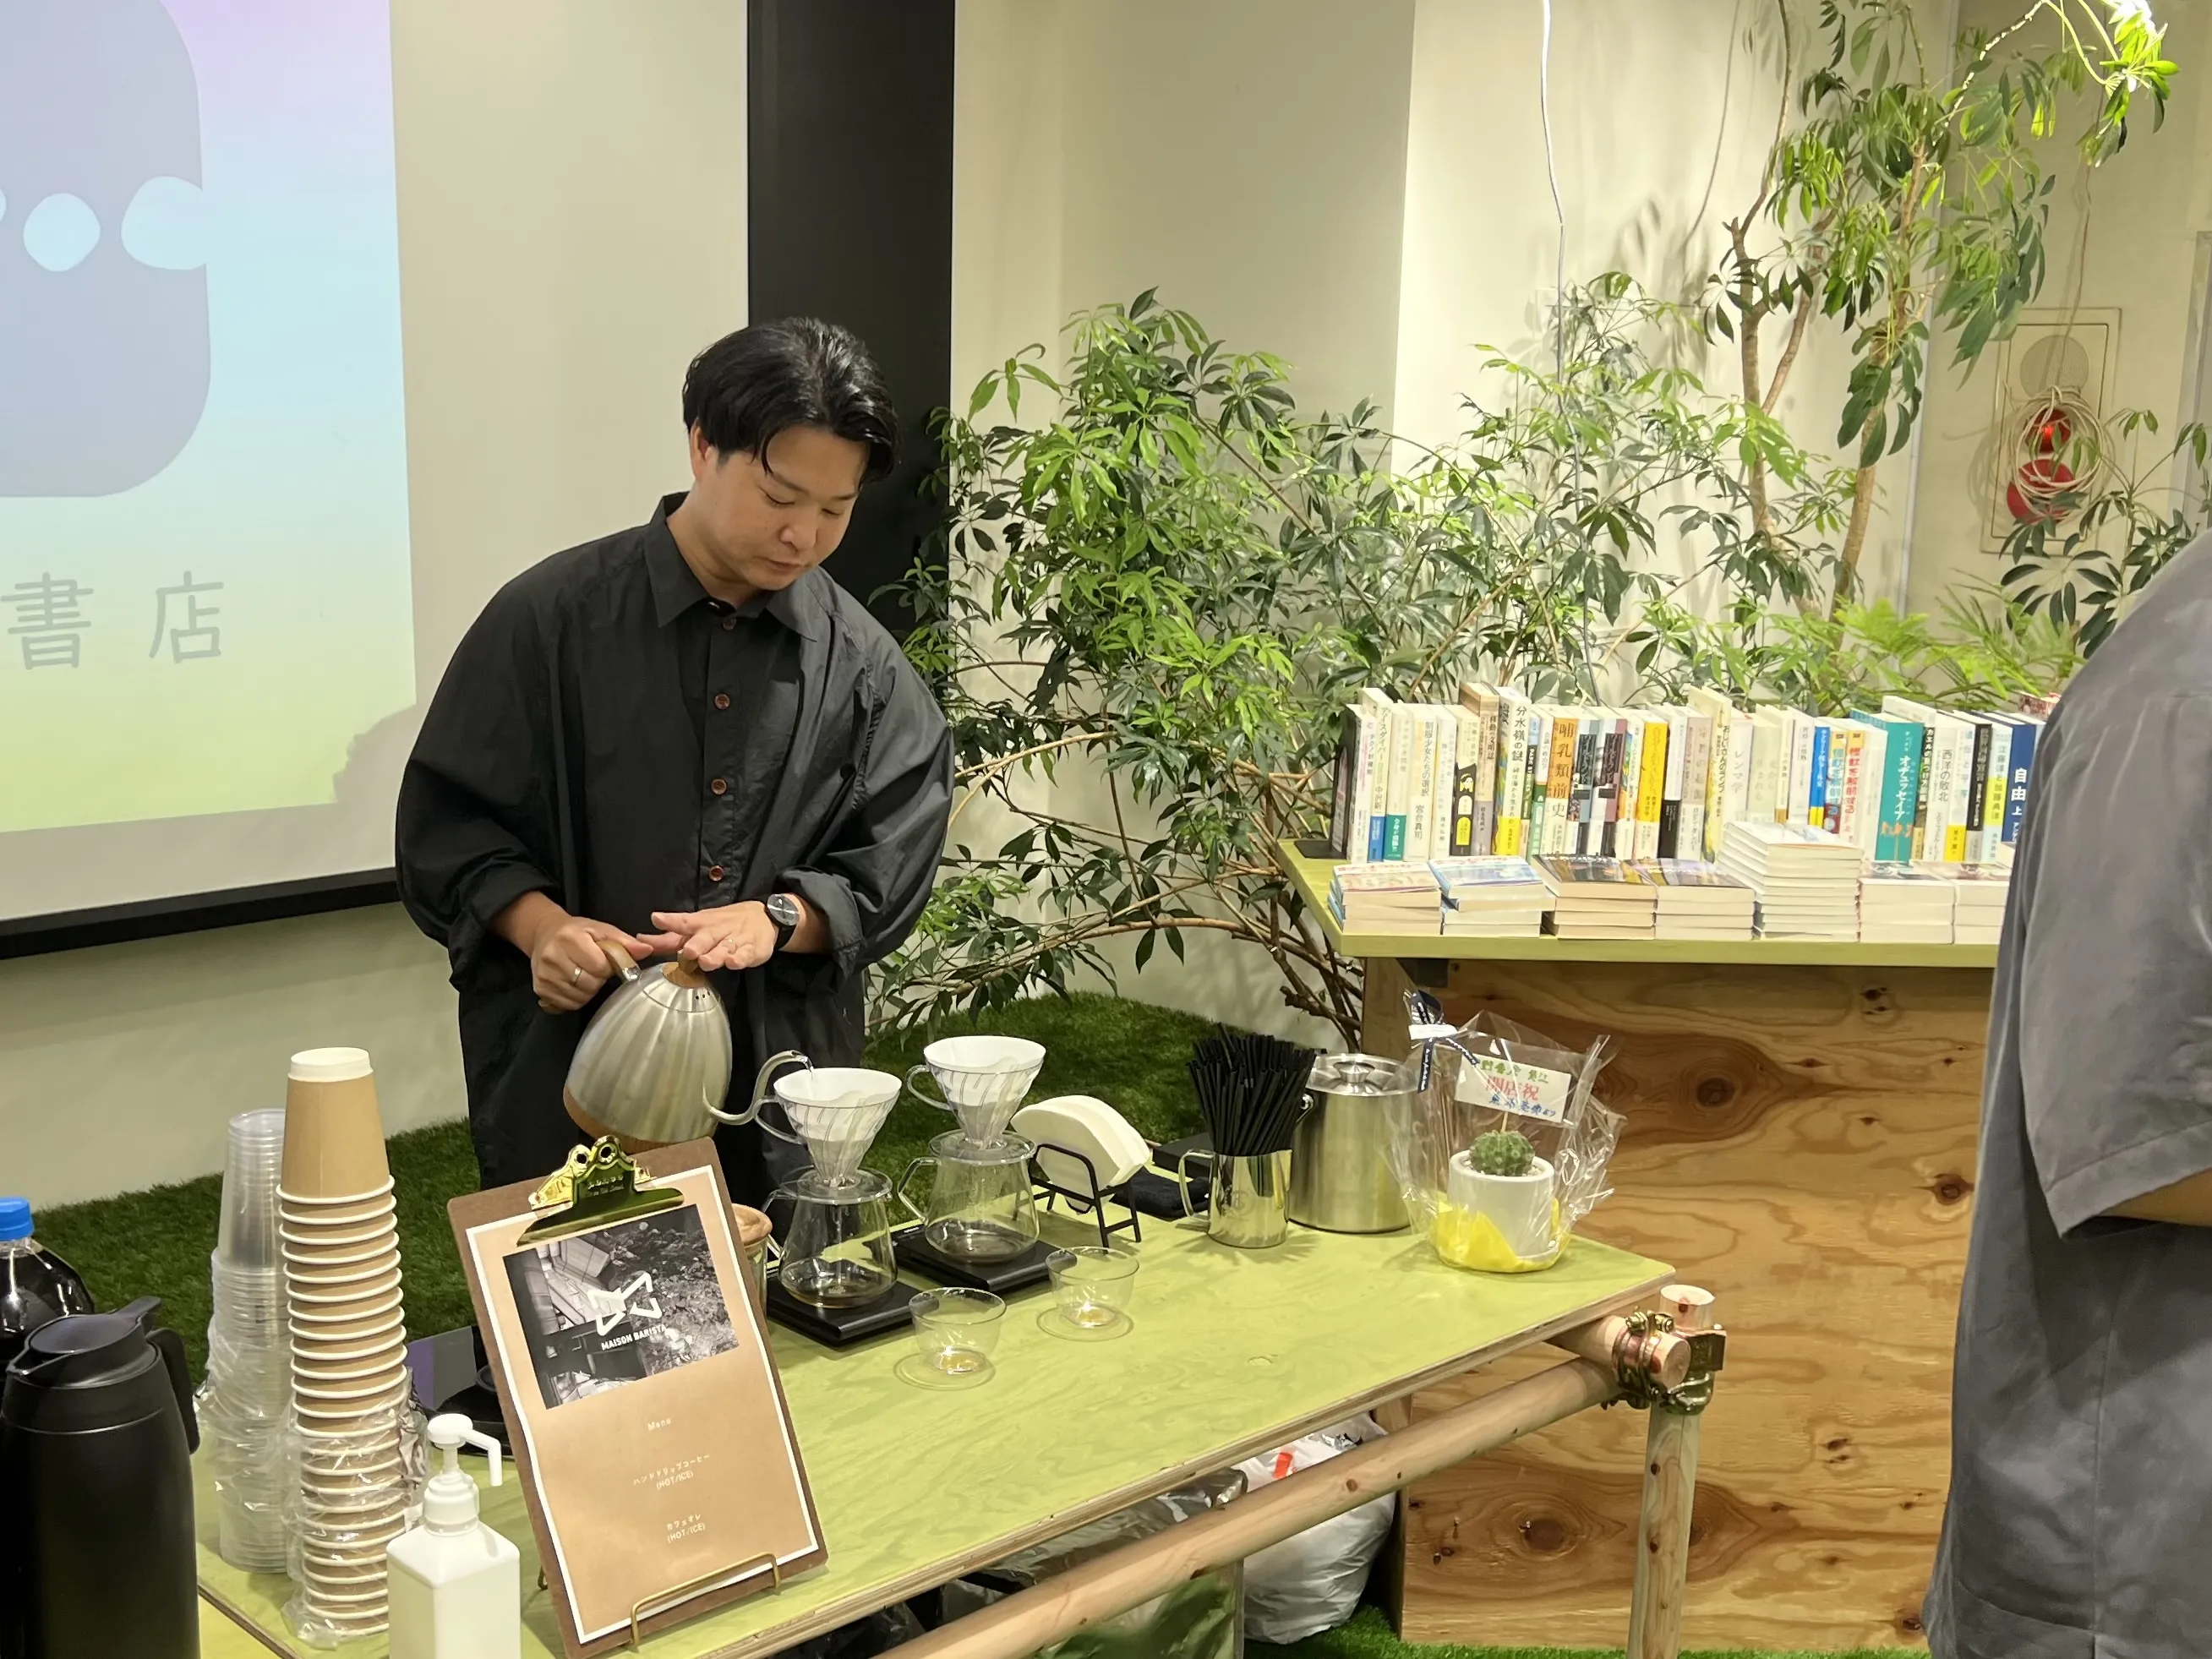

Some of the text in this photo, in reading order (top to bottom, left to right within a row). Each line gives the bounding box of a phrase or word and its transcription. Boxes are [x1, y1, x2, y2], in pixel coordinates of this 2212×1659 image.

[1511, 705, 1527, 762] 分水嶺の謎
[1421, 721, 1434, 797] 制服少女たちの選択
[1552, 721, 1576, 818] 哺乳類前史
[1731, 750, 1744, 794] レンマ学
[1938, 749, 1953, 803] 西洋の敗北
[1894, 755, 1912, 821] オデュッセイア
[2010, 767, 2028, 802] 自由
[601, 1323, 668, 1351] MAISON BARISTA
[666, 1513, 702, 1531] カフェオレ
[666, 1521, 707, 1544] (HOT/ICE)
